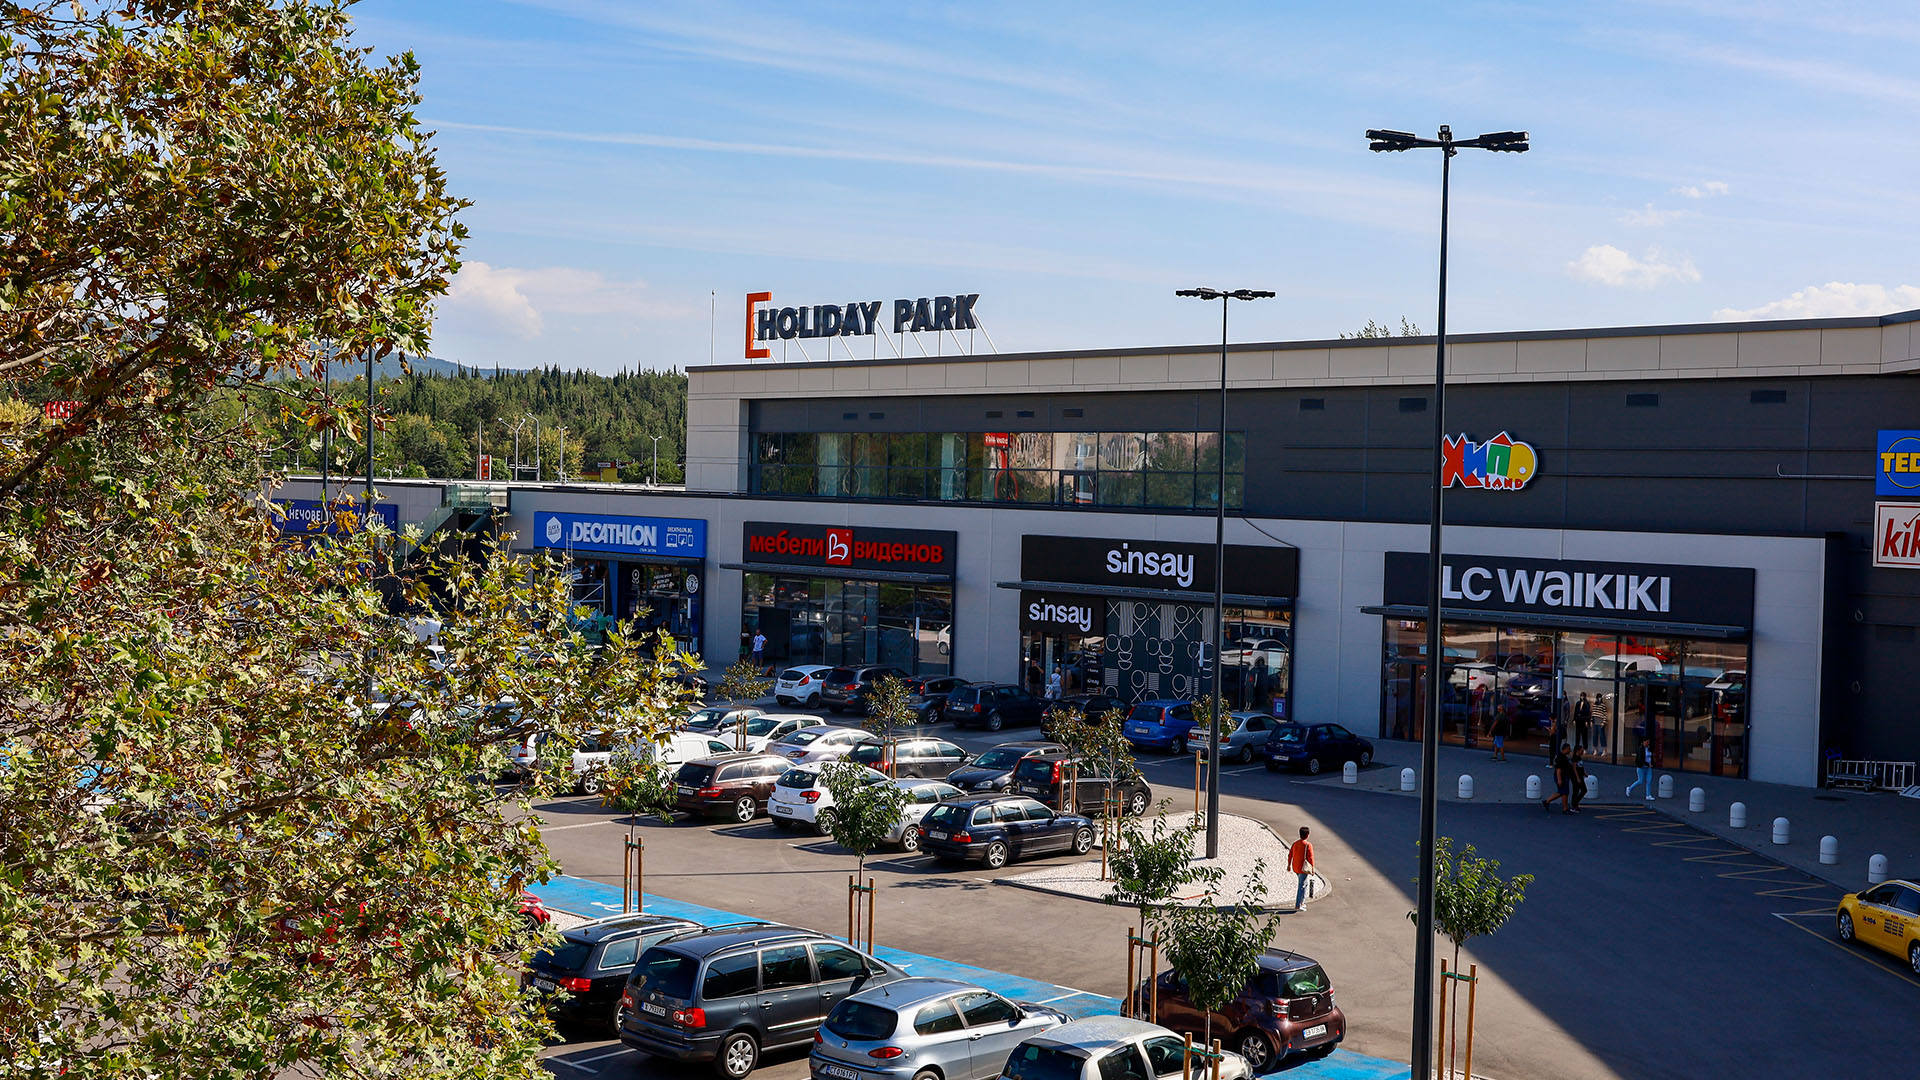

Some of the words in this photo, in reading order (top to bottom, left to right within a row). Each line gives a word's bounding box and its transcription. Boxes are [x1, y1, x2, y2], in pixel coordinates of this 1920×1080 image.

[758, 301, 882, 340] HOLIDAY
[893, 294, 979, 333] PARK
[1484, 474, 1524, 489] LAND
[572, 521, 657, 547] DECATHLON
[750, 530, 825, 554] мебели
[854, 541, 945, 563] виденов
[1106, 543, 1194, 588] sinsay
[1442, 565, 1493, 601] LC
[1029, 598, 1092, 632] sinsay
